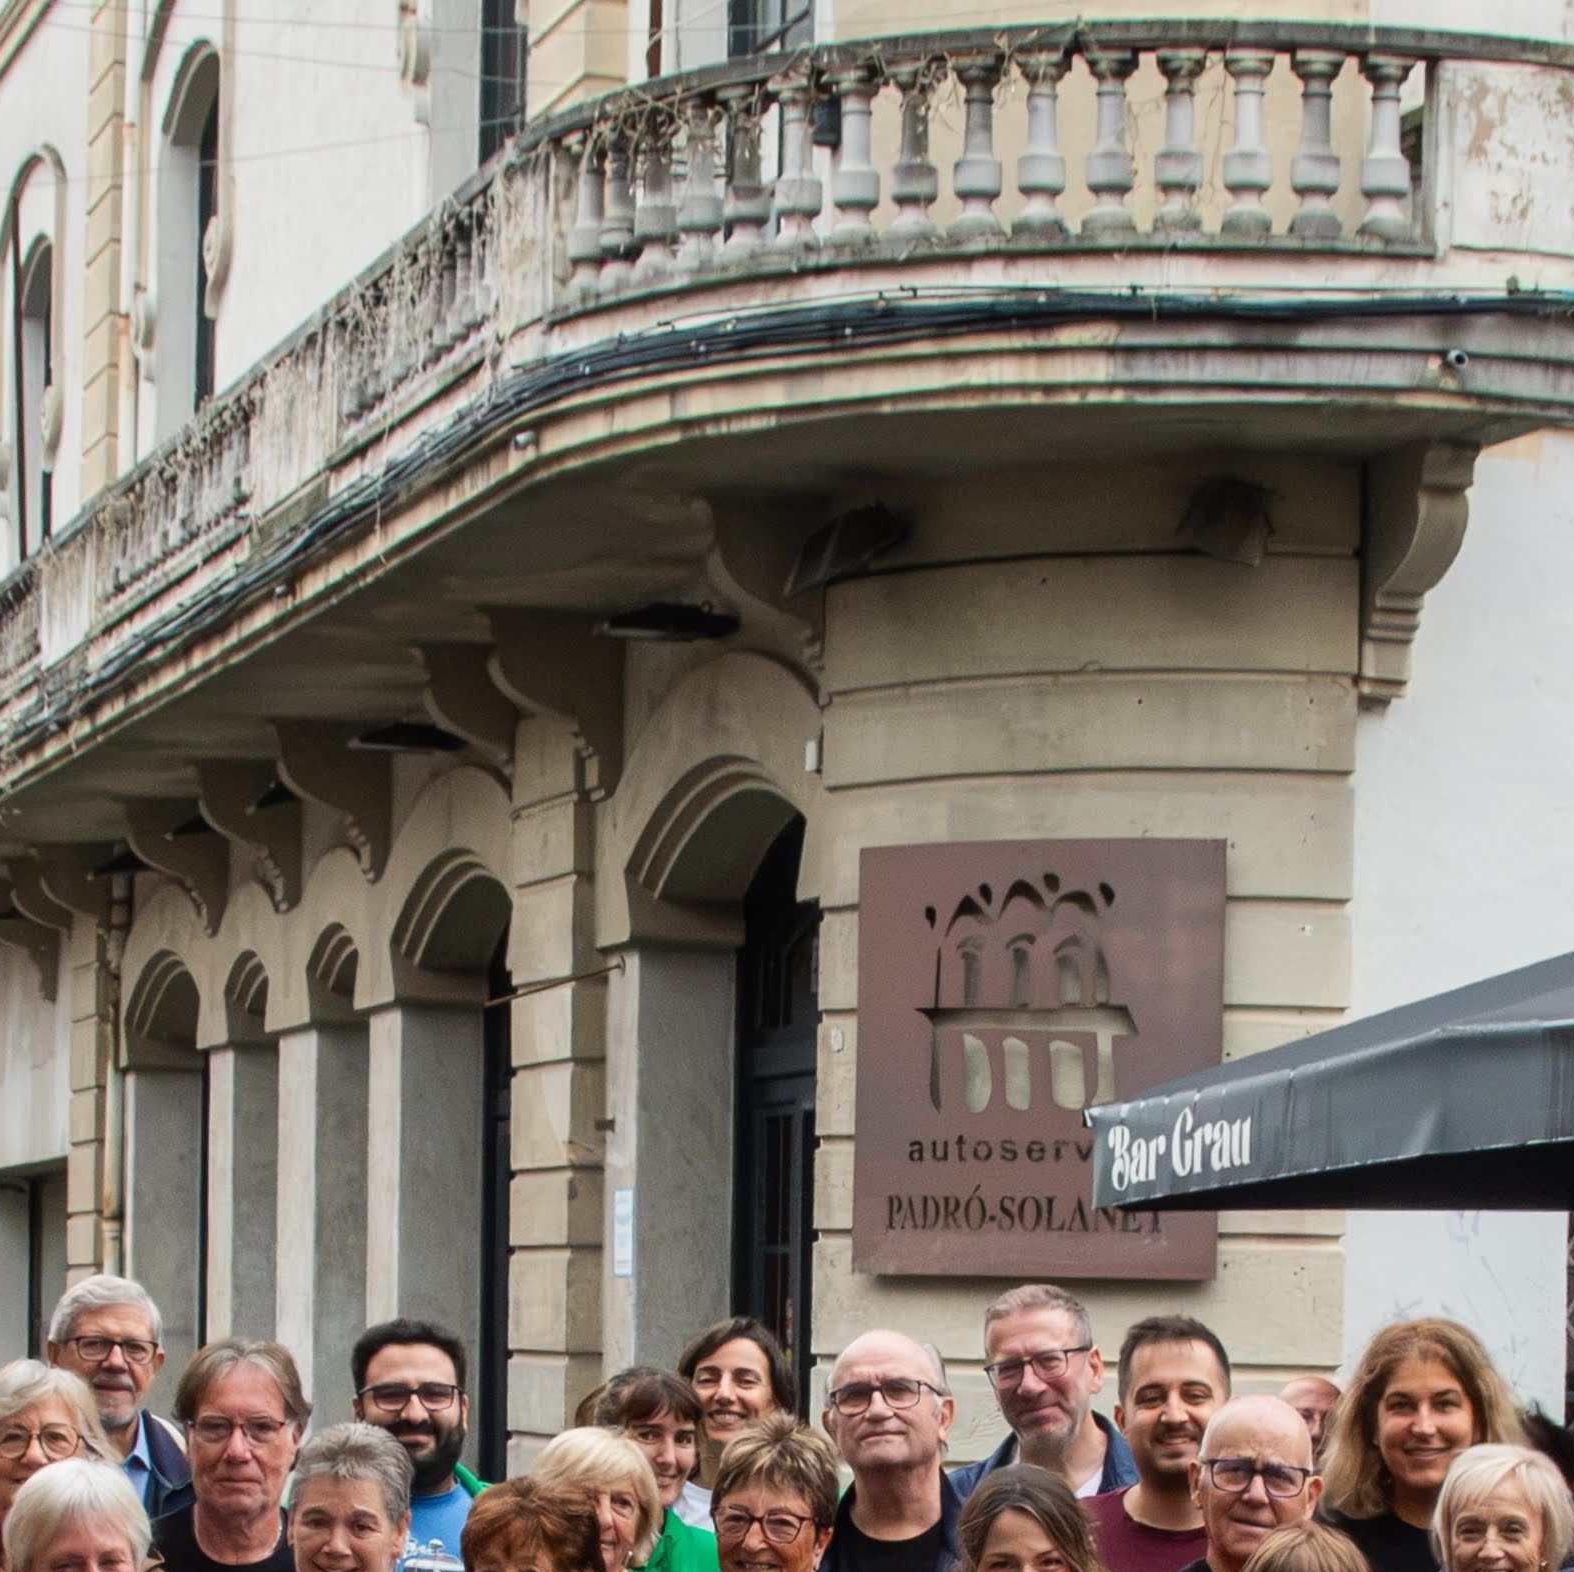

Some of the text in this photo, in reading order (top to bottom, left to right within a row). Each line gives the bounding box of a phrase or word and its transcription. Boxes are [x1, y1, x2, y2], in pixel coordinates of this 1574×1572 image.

[907, 1132, 1093, 1163] autoserv
[1107, 1106, 1252, 1192] Bar Grau
